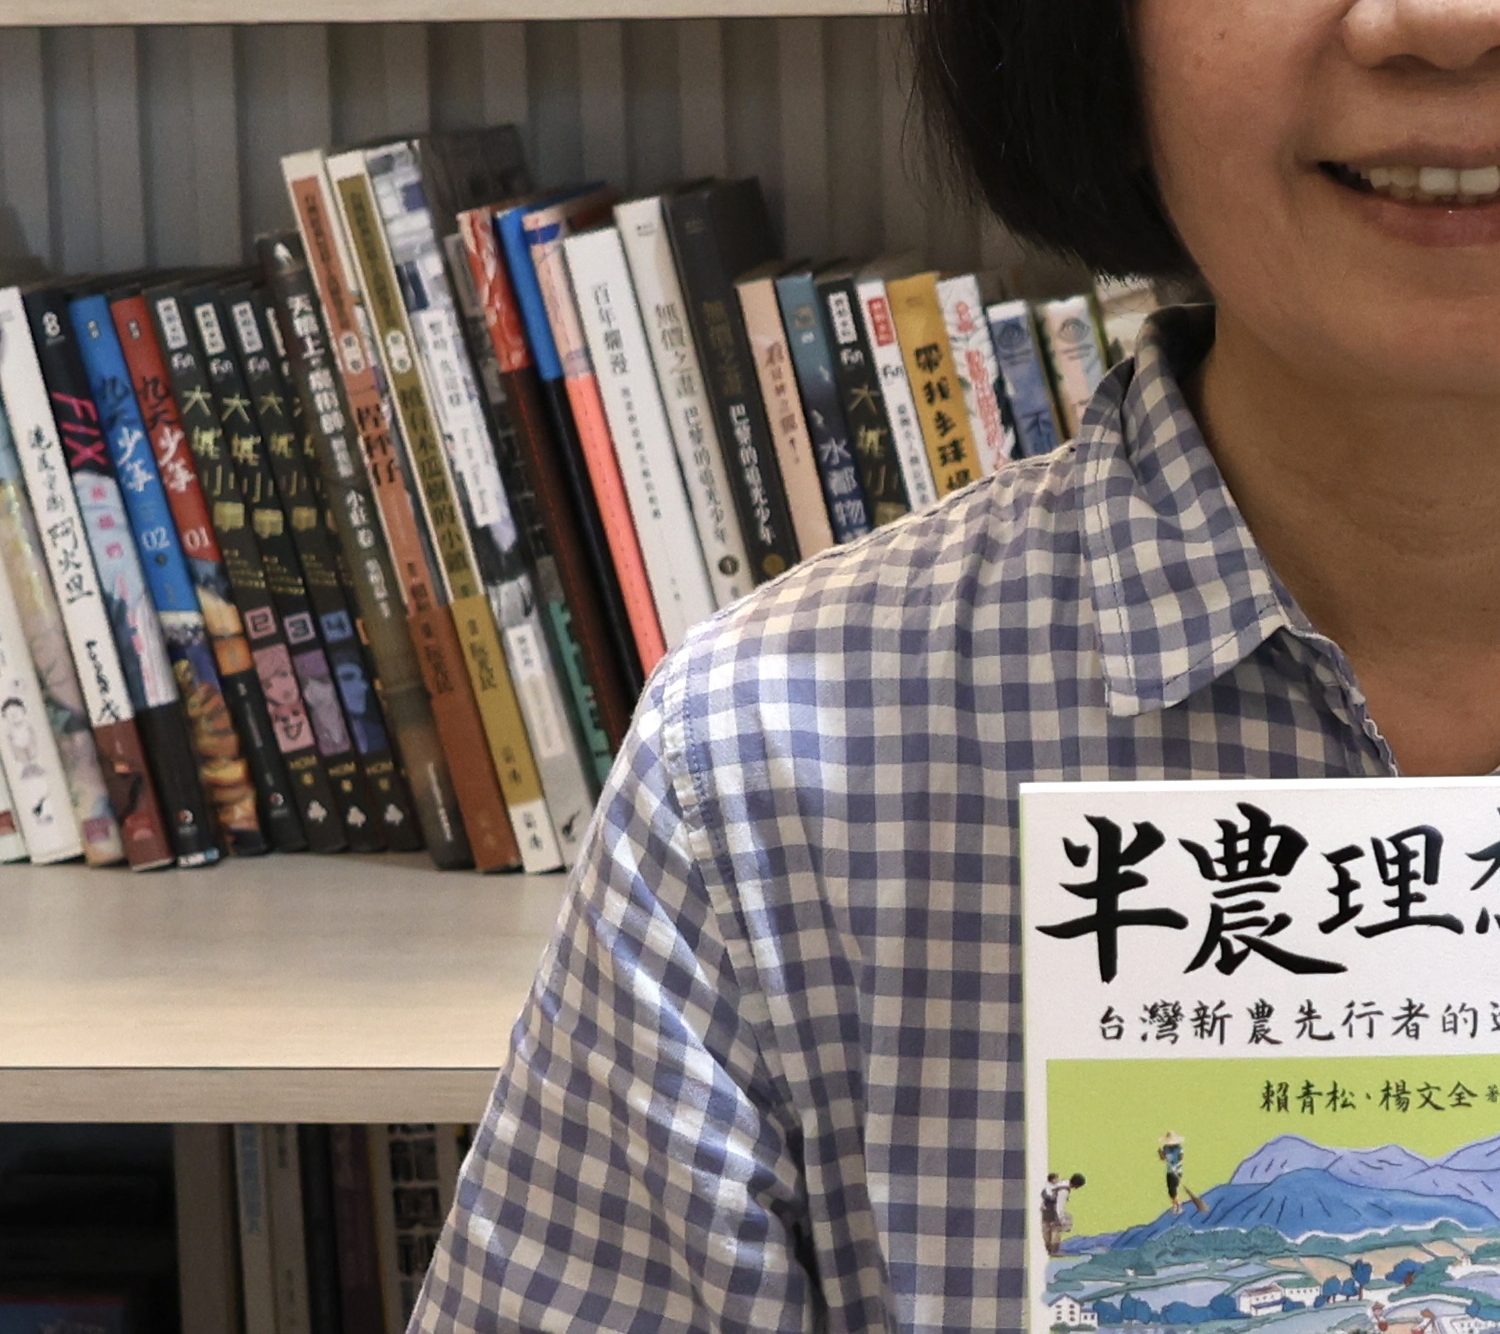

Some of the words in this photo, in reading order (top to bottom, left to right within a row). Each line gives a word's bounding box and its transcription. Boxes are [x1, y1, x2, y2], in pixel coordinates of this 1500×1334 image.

[141, 527, 168, 550] 02
[185, 527, 212, 549] 01
[1485, 1085, 1500, 1102] 著
